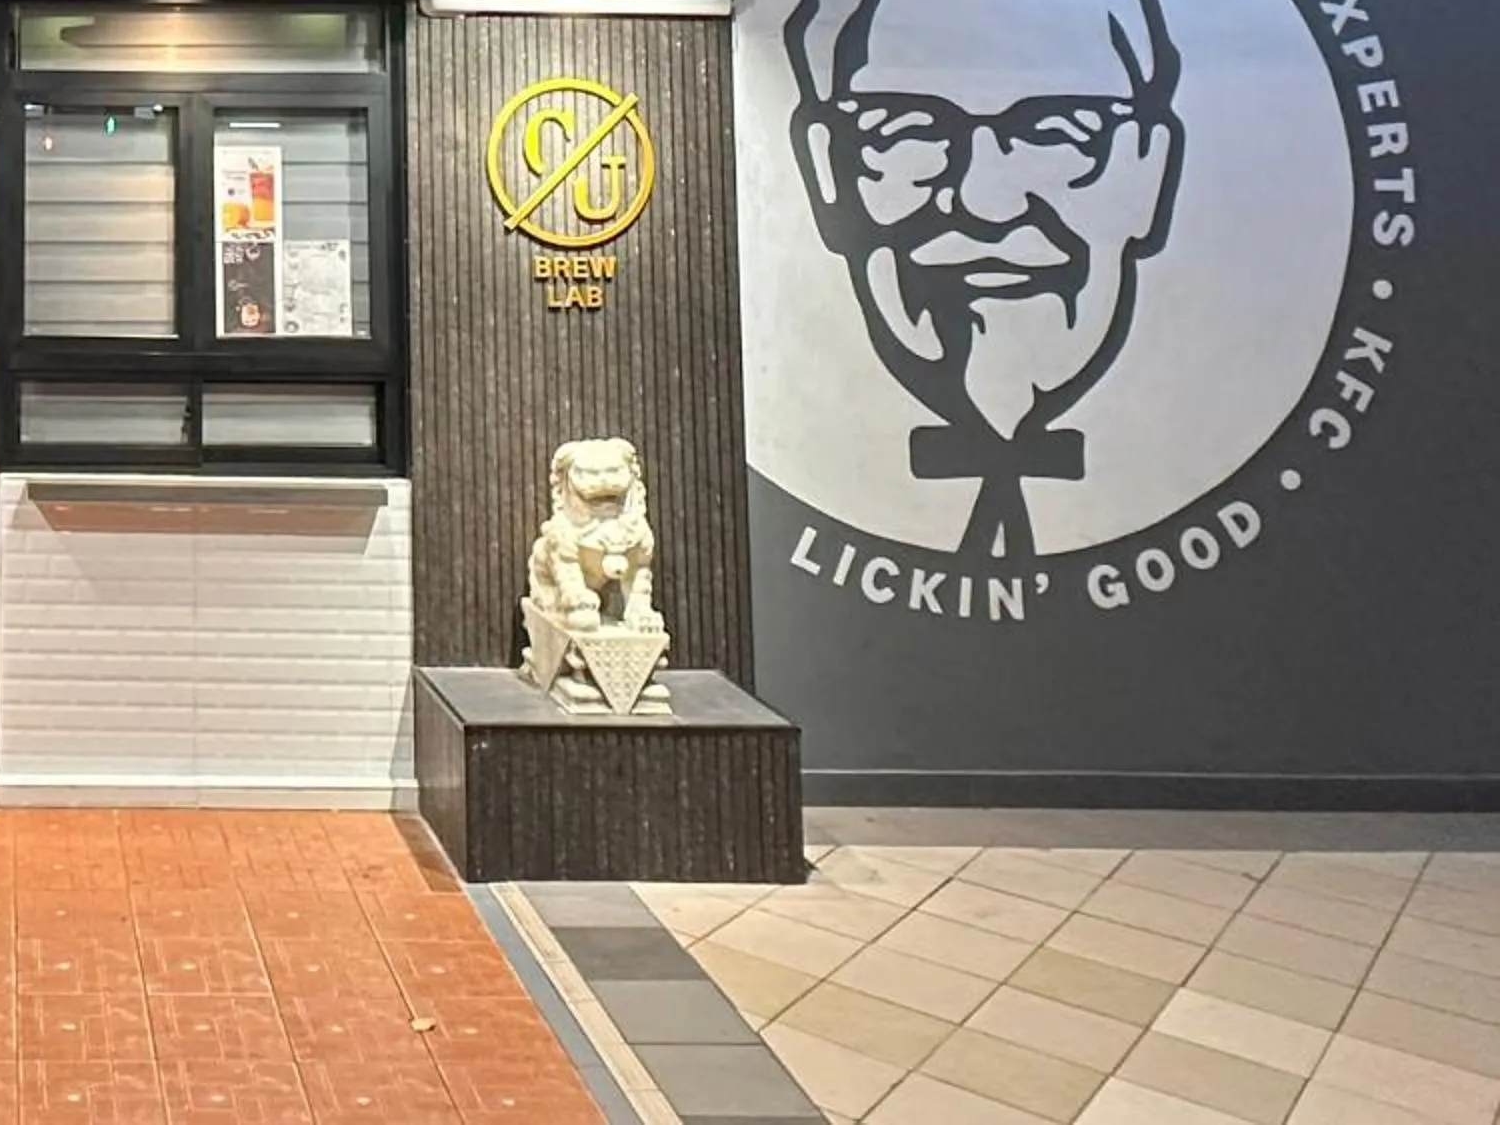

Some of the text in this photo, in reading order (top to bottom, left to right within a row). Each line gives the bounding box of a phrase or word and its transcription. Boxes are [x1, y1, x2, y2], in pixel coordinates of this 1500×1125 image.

[533, 255, 617, 279] BREW
[546, 285, 604, 308] LAB
[1308, 326, 1394, 449] KFC
[788, 500, 1262, 621] LICKIN' GOOD
